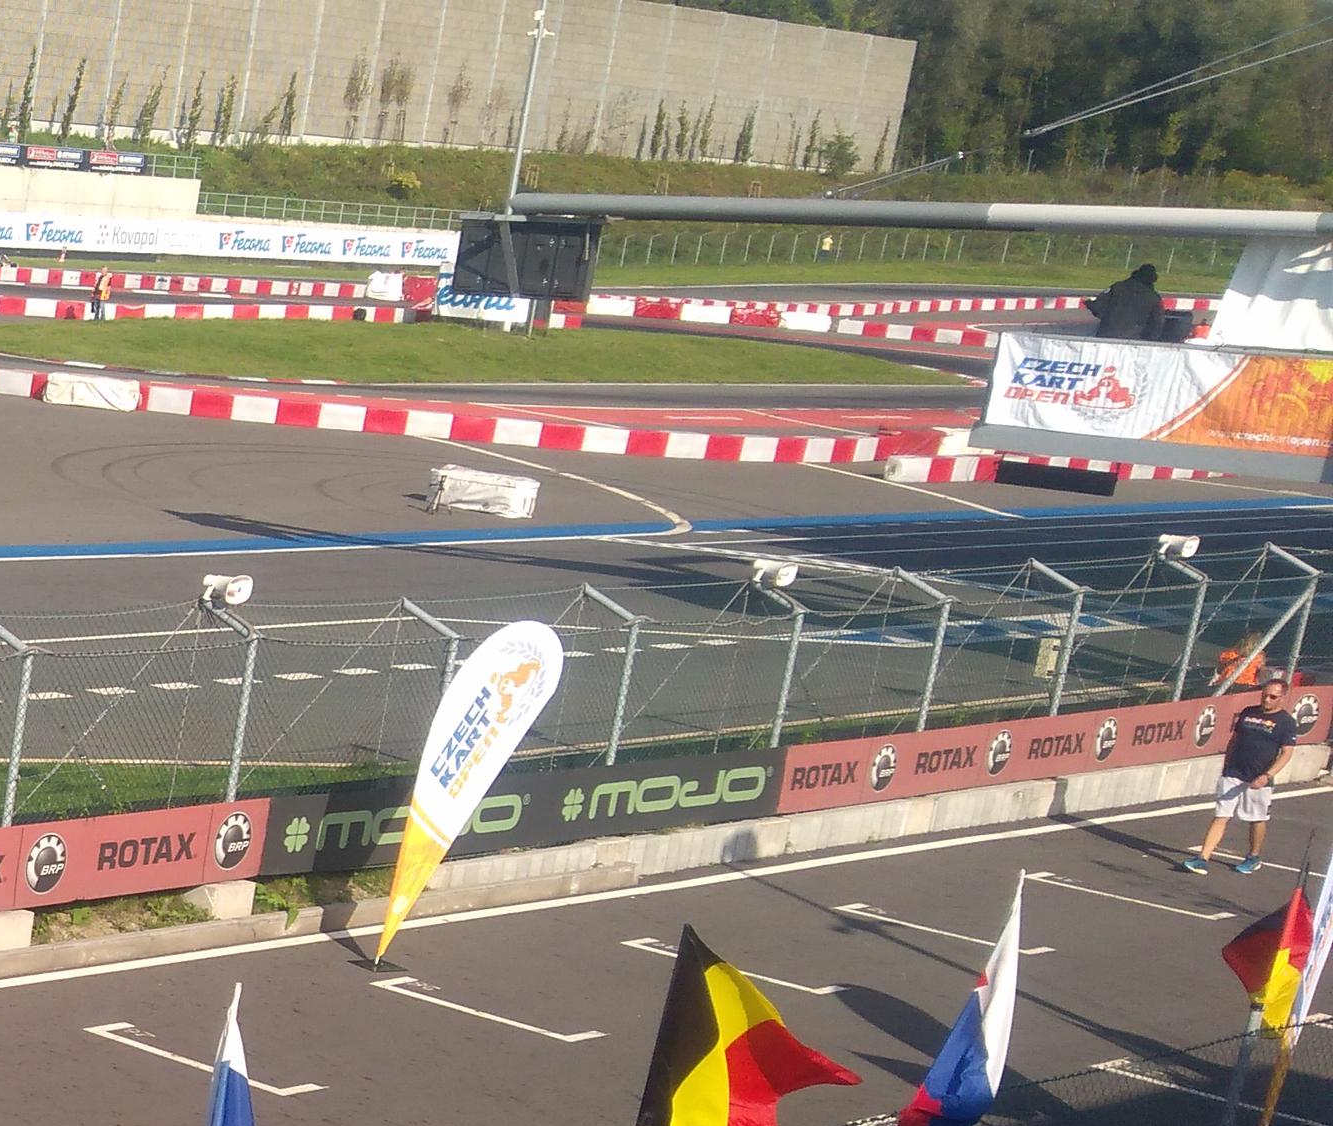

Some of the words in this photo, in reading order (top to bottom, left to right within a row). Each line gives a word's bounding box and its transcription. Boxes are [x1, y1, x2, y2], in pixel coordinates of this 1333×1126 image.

[38, 219, 83, 245] Ferona
[232, 230, 271, 253] Ferona
[292, 232, 332, 256] Ferona
[355, 236, 391, 258] Ferona
[412, 239, 448, 260] Ferona
[1018, 357, 1102, 376] CZECH
[1012, 371, 1083, 390] KART
[430, 686, 492, 777] CZECH
[1132, 719, 1187, 746] ROTAX
[439, 709, 491, 788] KART
[1027, 731, 1086, 759] ROTAX
[914, 745, 979, 777] ROTAX
[790, 760, 860, 791] ROTAX
[97, 832, 197, 871] ROTAX
[227, 840, 251, 853] BRP
[40, 862, 65, 877] BRP
